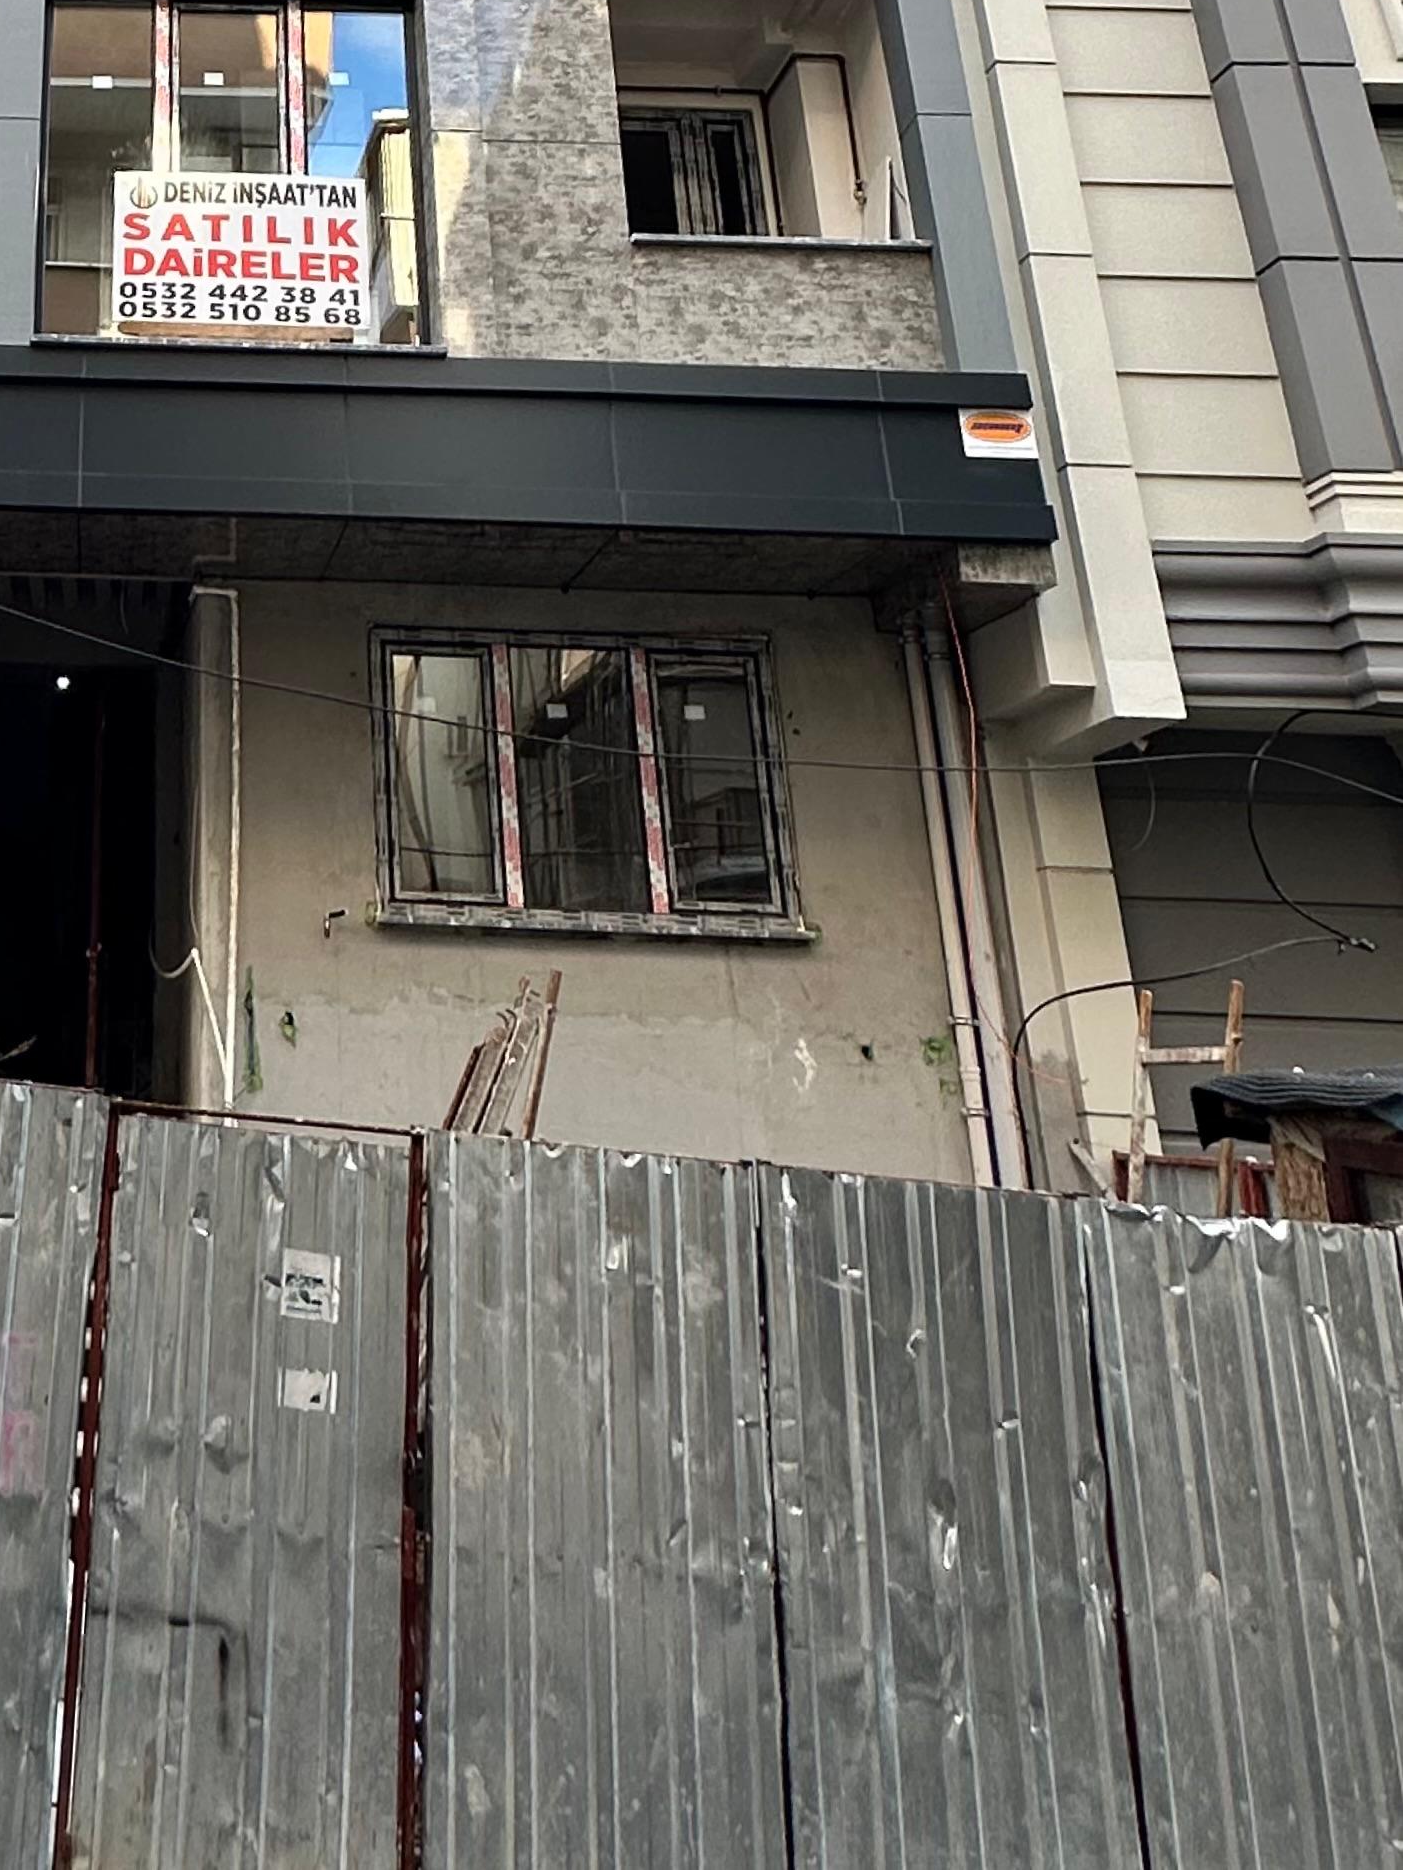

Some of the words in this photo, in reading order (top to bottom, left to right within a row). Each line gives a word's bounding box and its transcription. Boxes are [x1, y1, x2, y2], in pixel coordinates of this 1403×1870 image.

[123, 213, 359, 248] SATILIK
[119, 282, 196, 300] 0532
[208, 284, 268, 303] 442
[281, 287, 316, 304] 38
[329, 288, 360, 307] 41
[119, 301, 196, 319] 0532
[209, 303, 262, 321] 510
[275, 306, 311, 323] 85
[324, 308, 361, 326] 68
